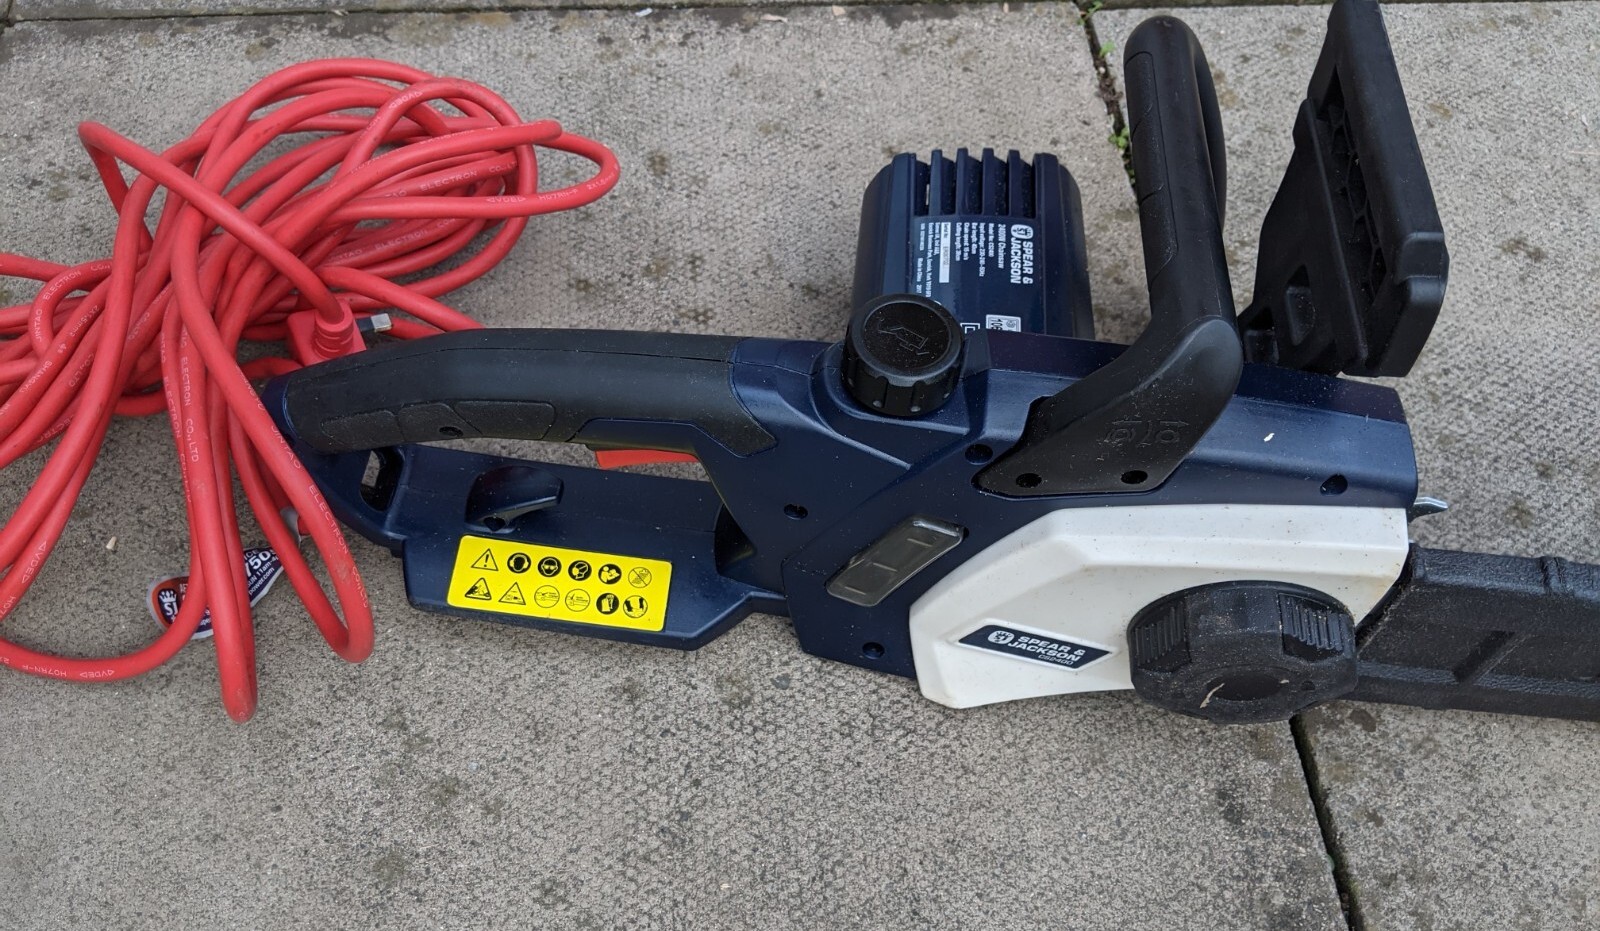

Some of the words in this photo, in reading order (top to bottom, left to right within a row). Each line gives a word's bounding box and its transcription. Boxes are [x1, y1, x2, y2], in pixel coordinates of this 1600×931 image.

[419, 170, 478, 191] ELECTRON
[375, 230, 429, 250] ELECTRON
[998, 223, 1007, 241] 2400W
[997, 242, 1007, 269] Chainsaw
[1010, 237, 1022, 284] JACKSON
[1022, 241, 1034, 275] SPEAR
[43, 270, 82, 300] ELECTRON
[1022, 276, 1034, 285] &
[181, 356, 191, 406] ELECTRON
[271, 425, 301, 469] JINTAO
[308, 484, 348, 554] ELECTRON
[1008, 642, 1081, 662] JACKSON
[1017, 636, 1072, 653] SPEAR
[1073, 648, 1086, 656] &
